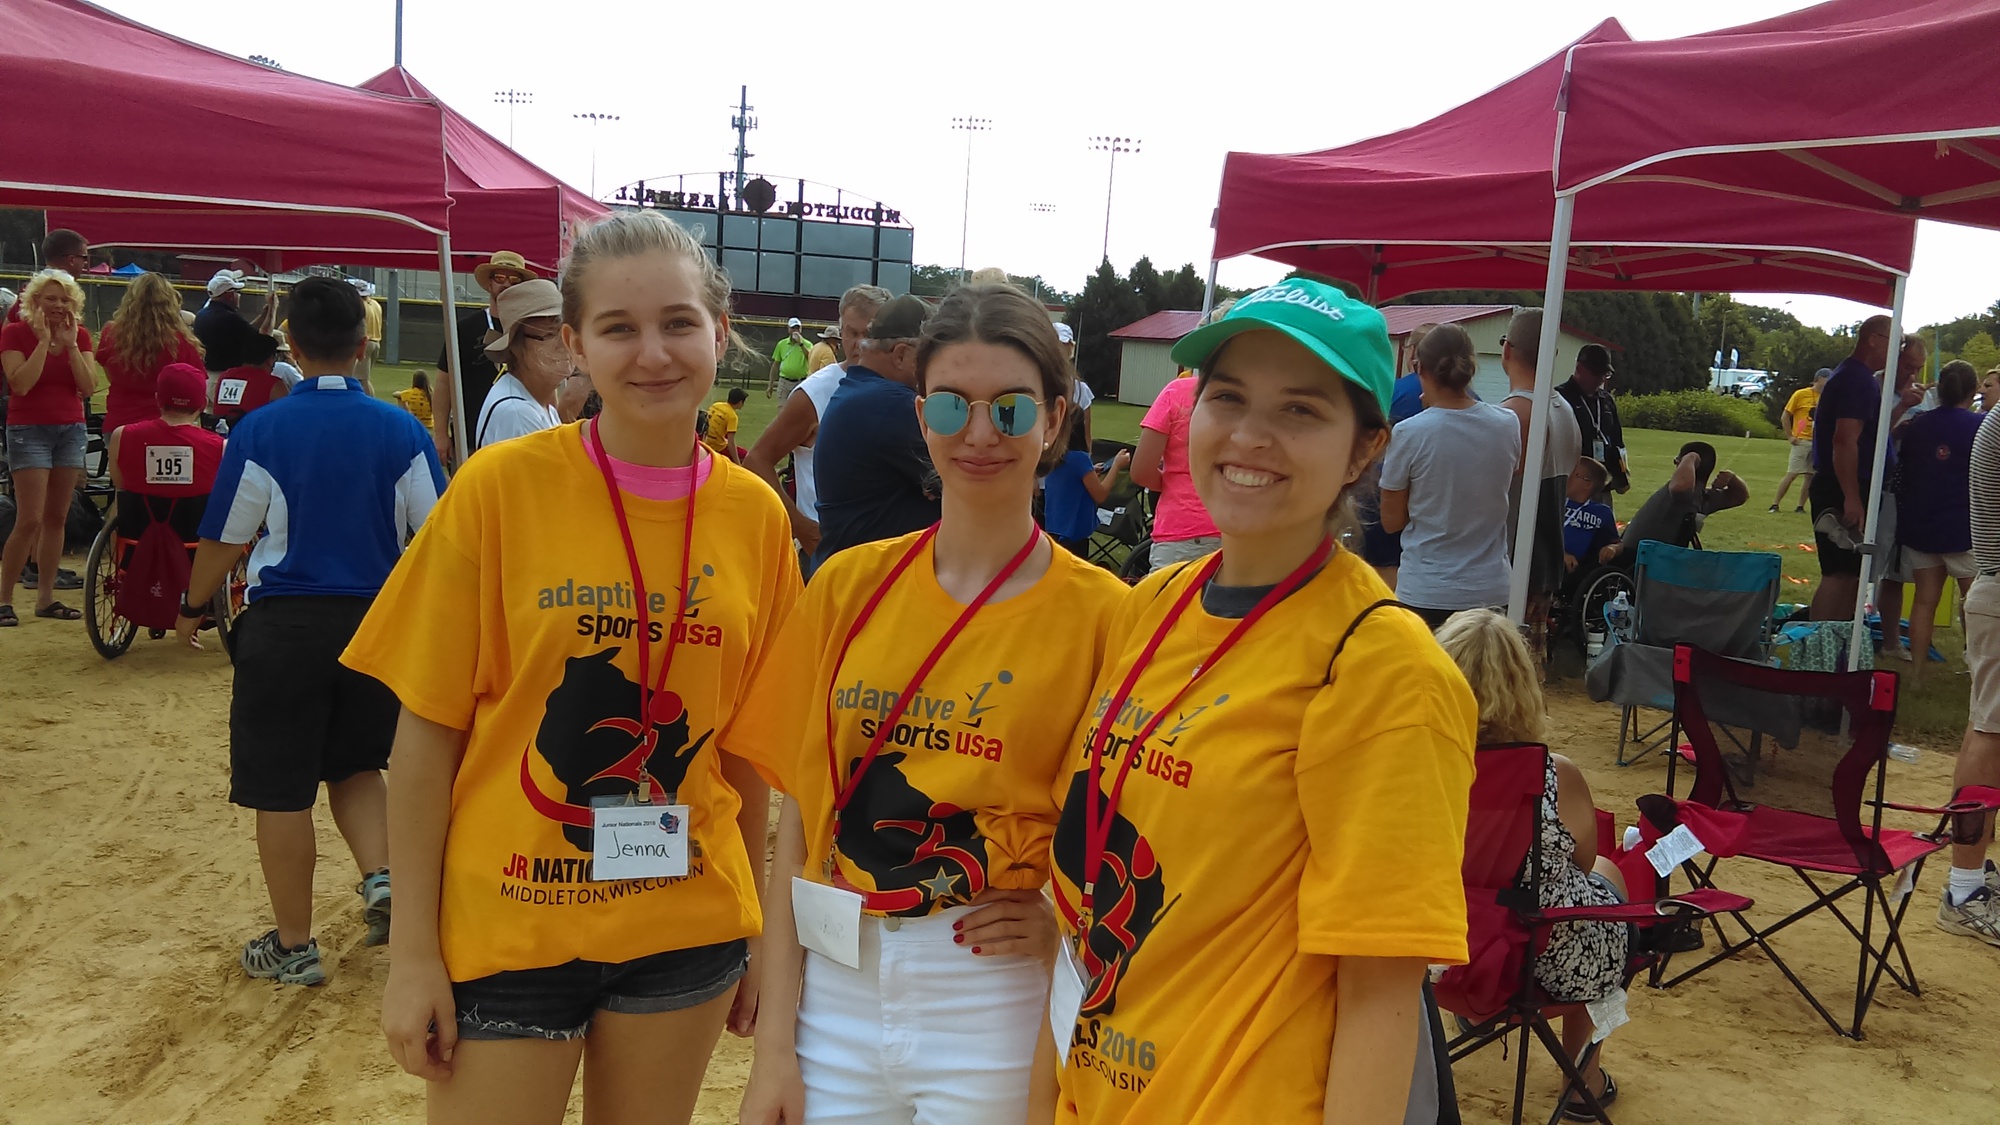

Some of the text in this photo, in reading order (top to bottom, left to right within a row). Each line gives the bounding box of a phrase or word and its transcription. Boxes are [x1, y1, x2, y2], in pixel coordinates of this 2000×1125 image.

[1235, 284, 1345, 320] Titleist
[223, 387, 239, 399] 244
[156, 458, 182, 475] 195
[538, 579, 665, 613] adaptie
[577, 613, 722, 647] spors usa
[836, 680, 955, 720] adapive
[955, 731, 1004, 762] usa
[1146, 749, 1193, 789] usa
[606, 830, 670, 859] Jenna
[503, 852, 528, 880] JR
[608, 863, 704, 899] WISCON
[1101, 1026, 1156, 1071] 2016
[1070, 1050, 1151, 1095] ISCONSIN
